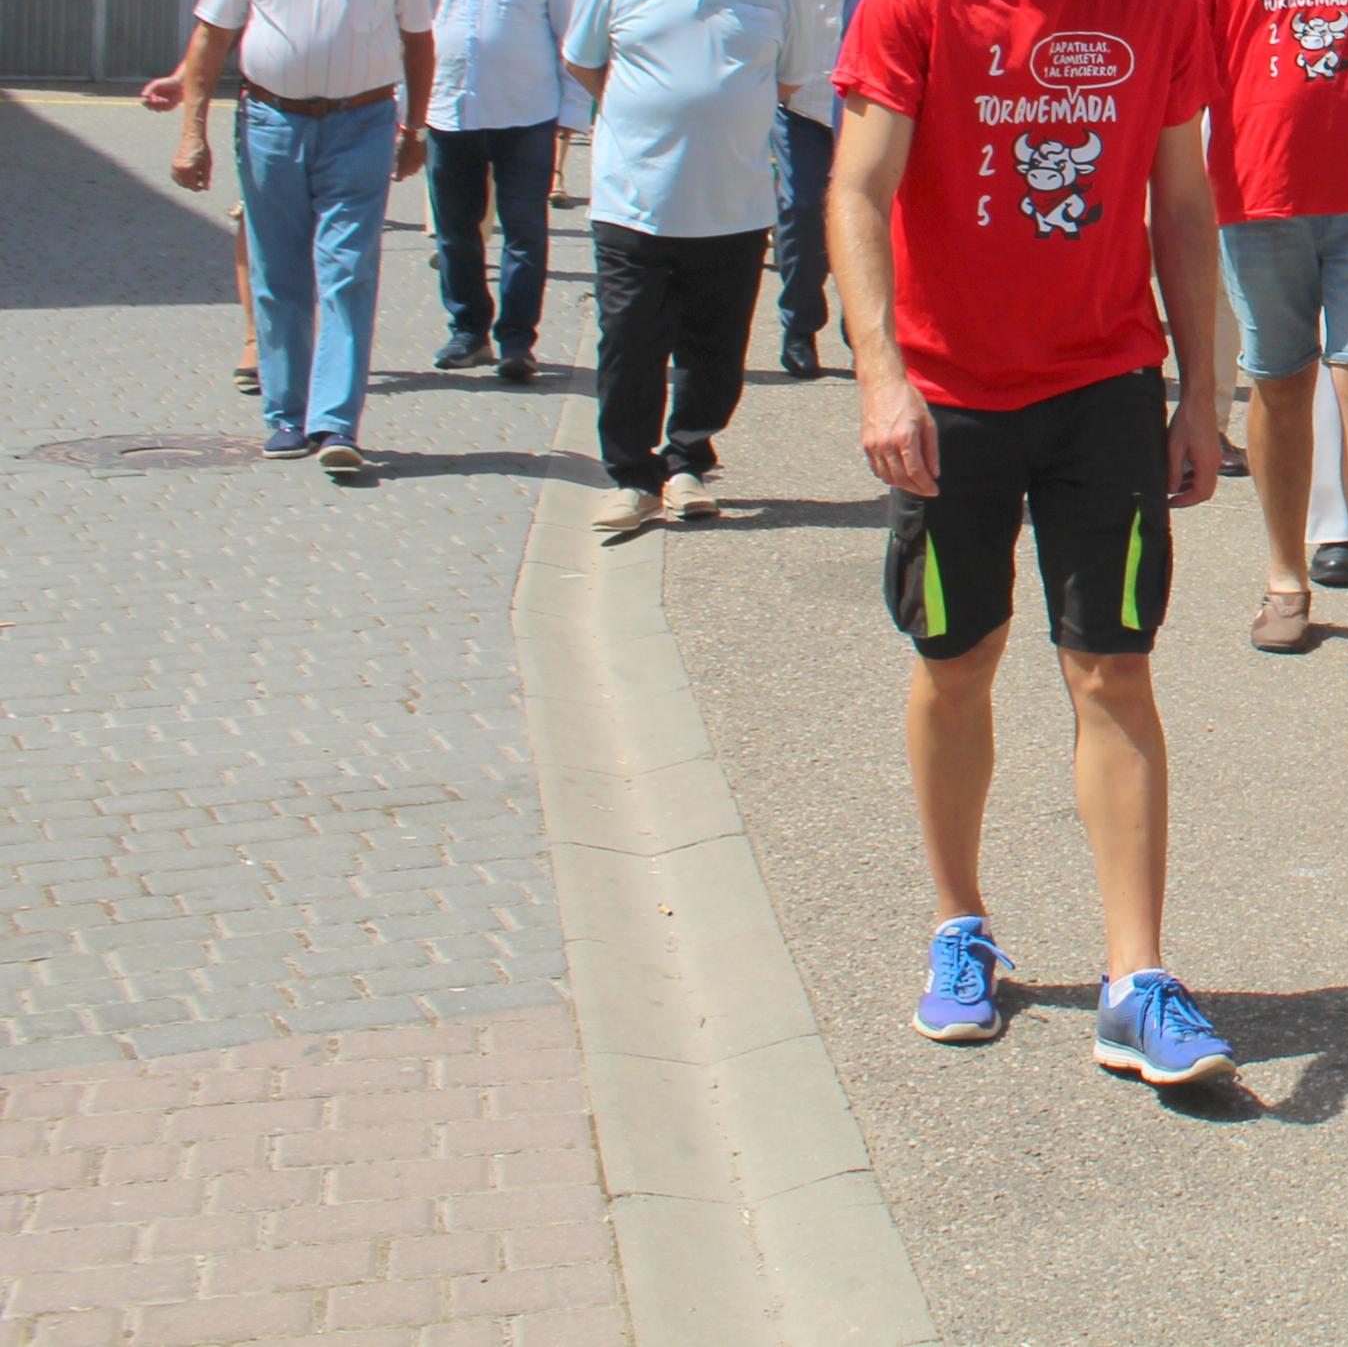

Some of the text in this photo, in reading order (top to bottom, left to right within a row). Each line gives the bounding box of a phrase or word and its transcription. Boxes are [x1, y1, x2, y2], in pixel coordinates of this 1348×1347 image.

[1269, 23, 1280, 44] 2
[989, 44, 1004, 76] 2
[1270, 56, 1279, 77] 5
[974, 95, 1117, 126] TORQUEMADA
[978, 144, 996, 176] 2
[977, 195, 992, 227] 5
